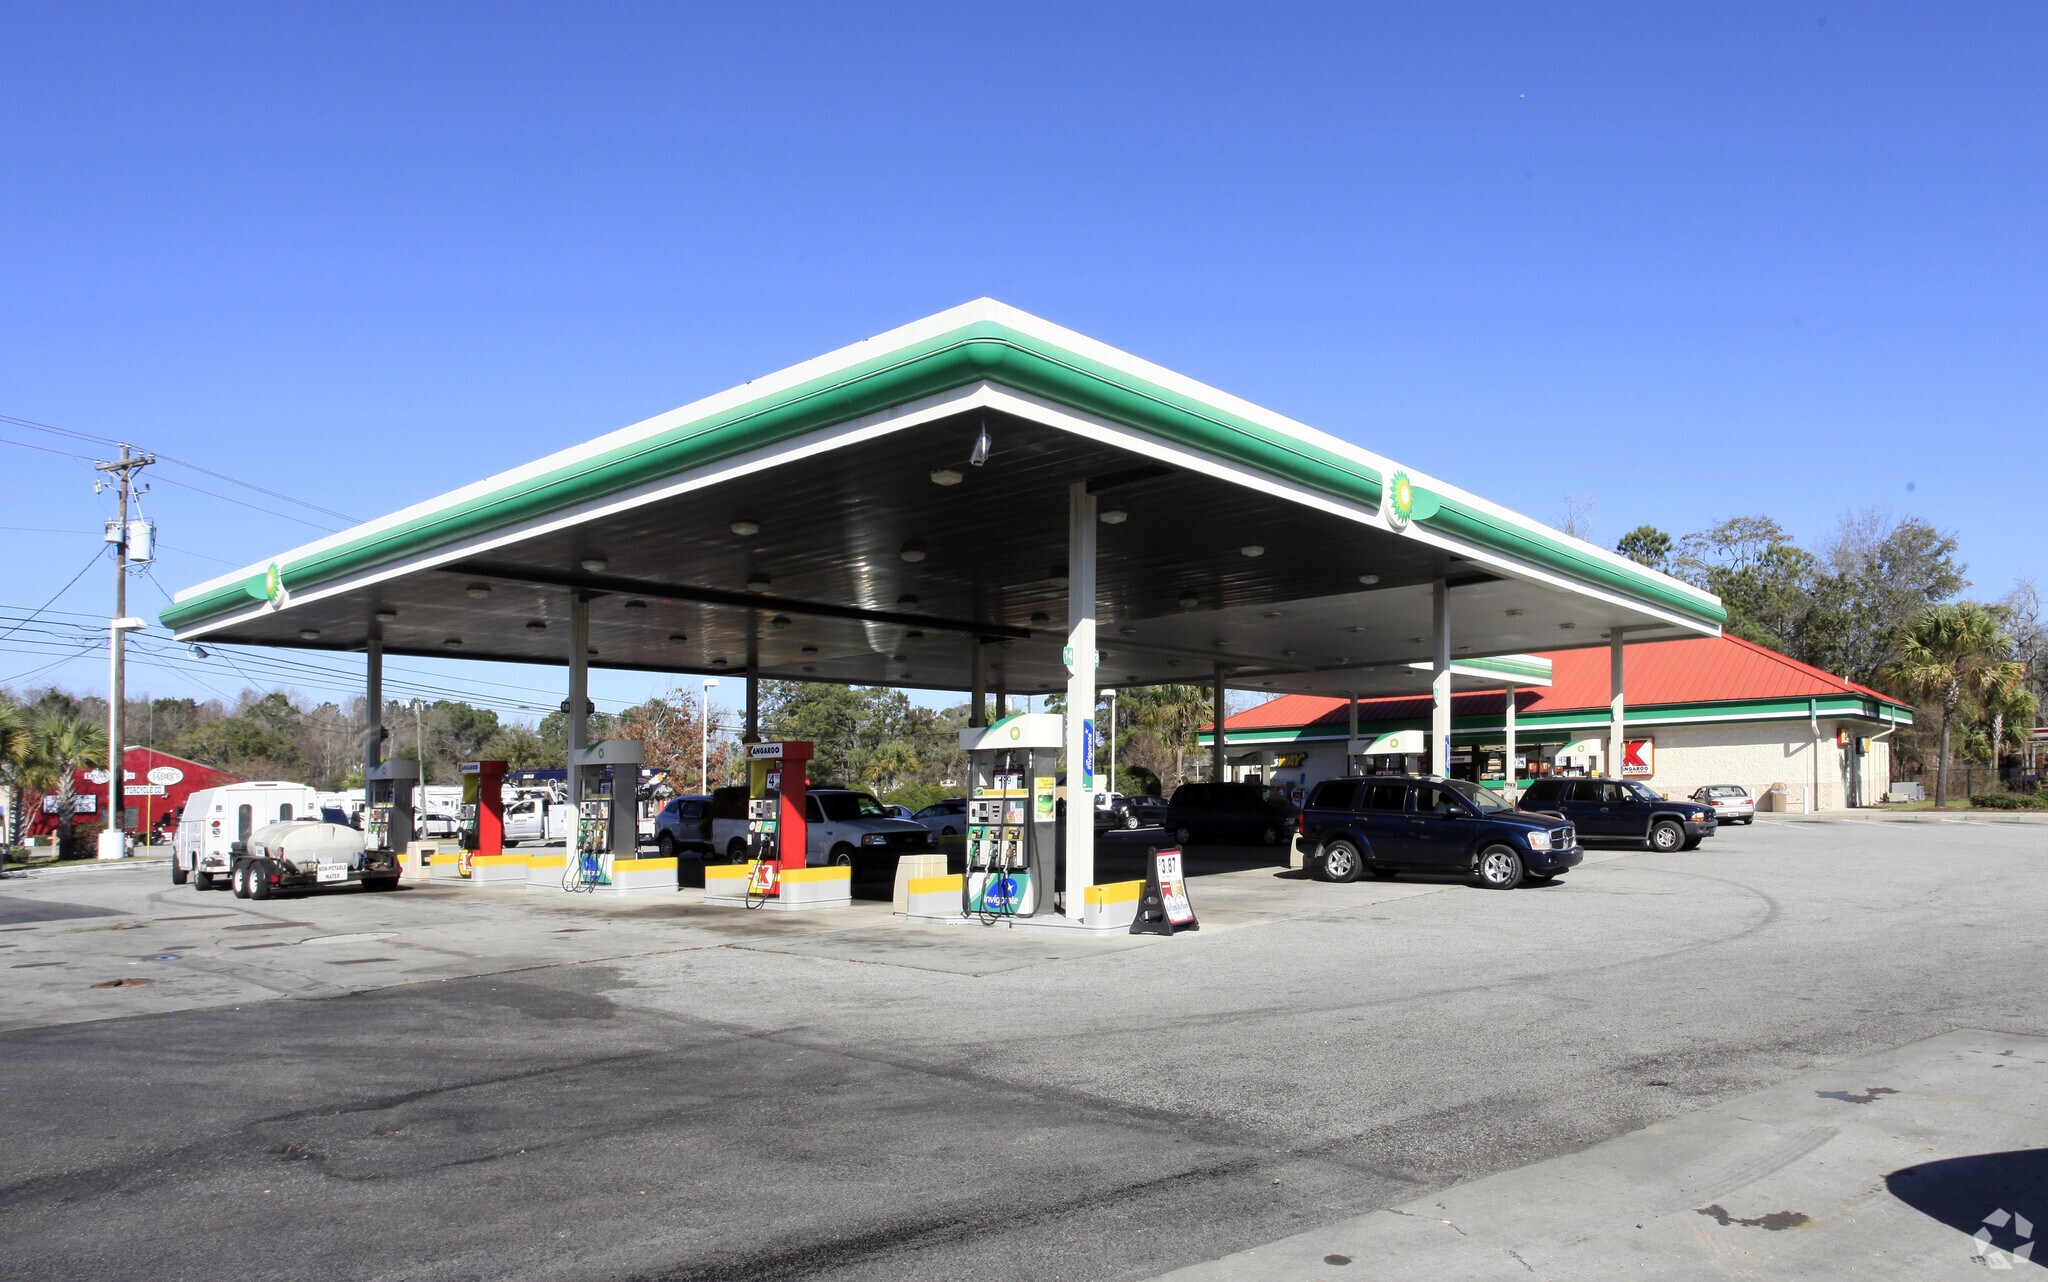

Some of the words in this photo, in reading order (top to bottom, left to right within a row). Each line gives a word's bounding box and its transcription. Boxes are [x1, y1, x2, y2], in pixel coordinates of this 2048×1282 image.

[1064, 650, 1073, 660] 14
[746, 746, 780, 758] KANGAROO
[126, 786, 153, 794] TORCYCLE
[318, 864, 347, 873] NON-POTABLE
